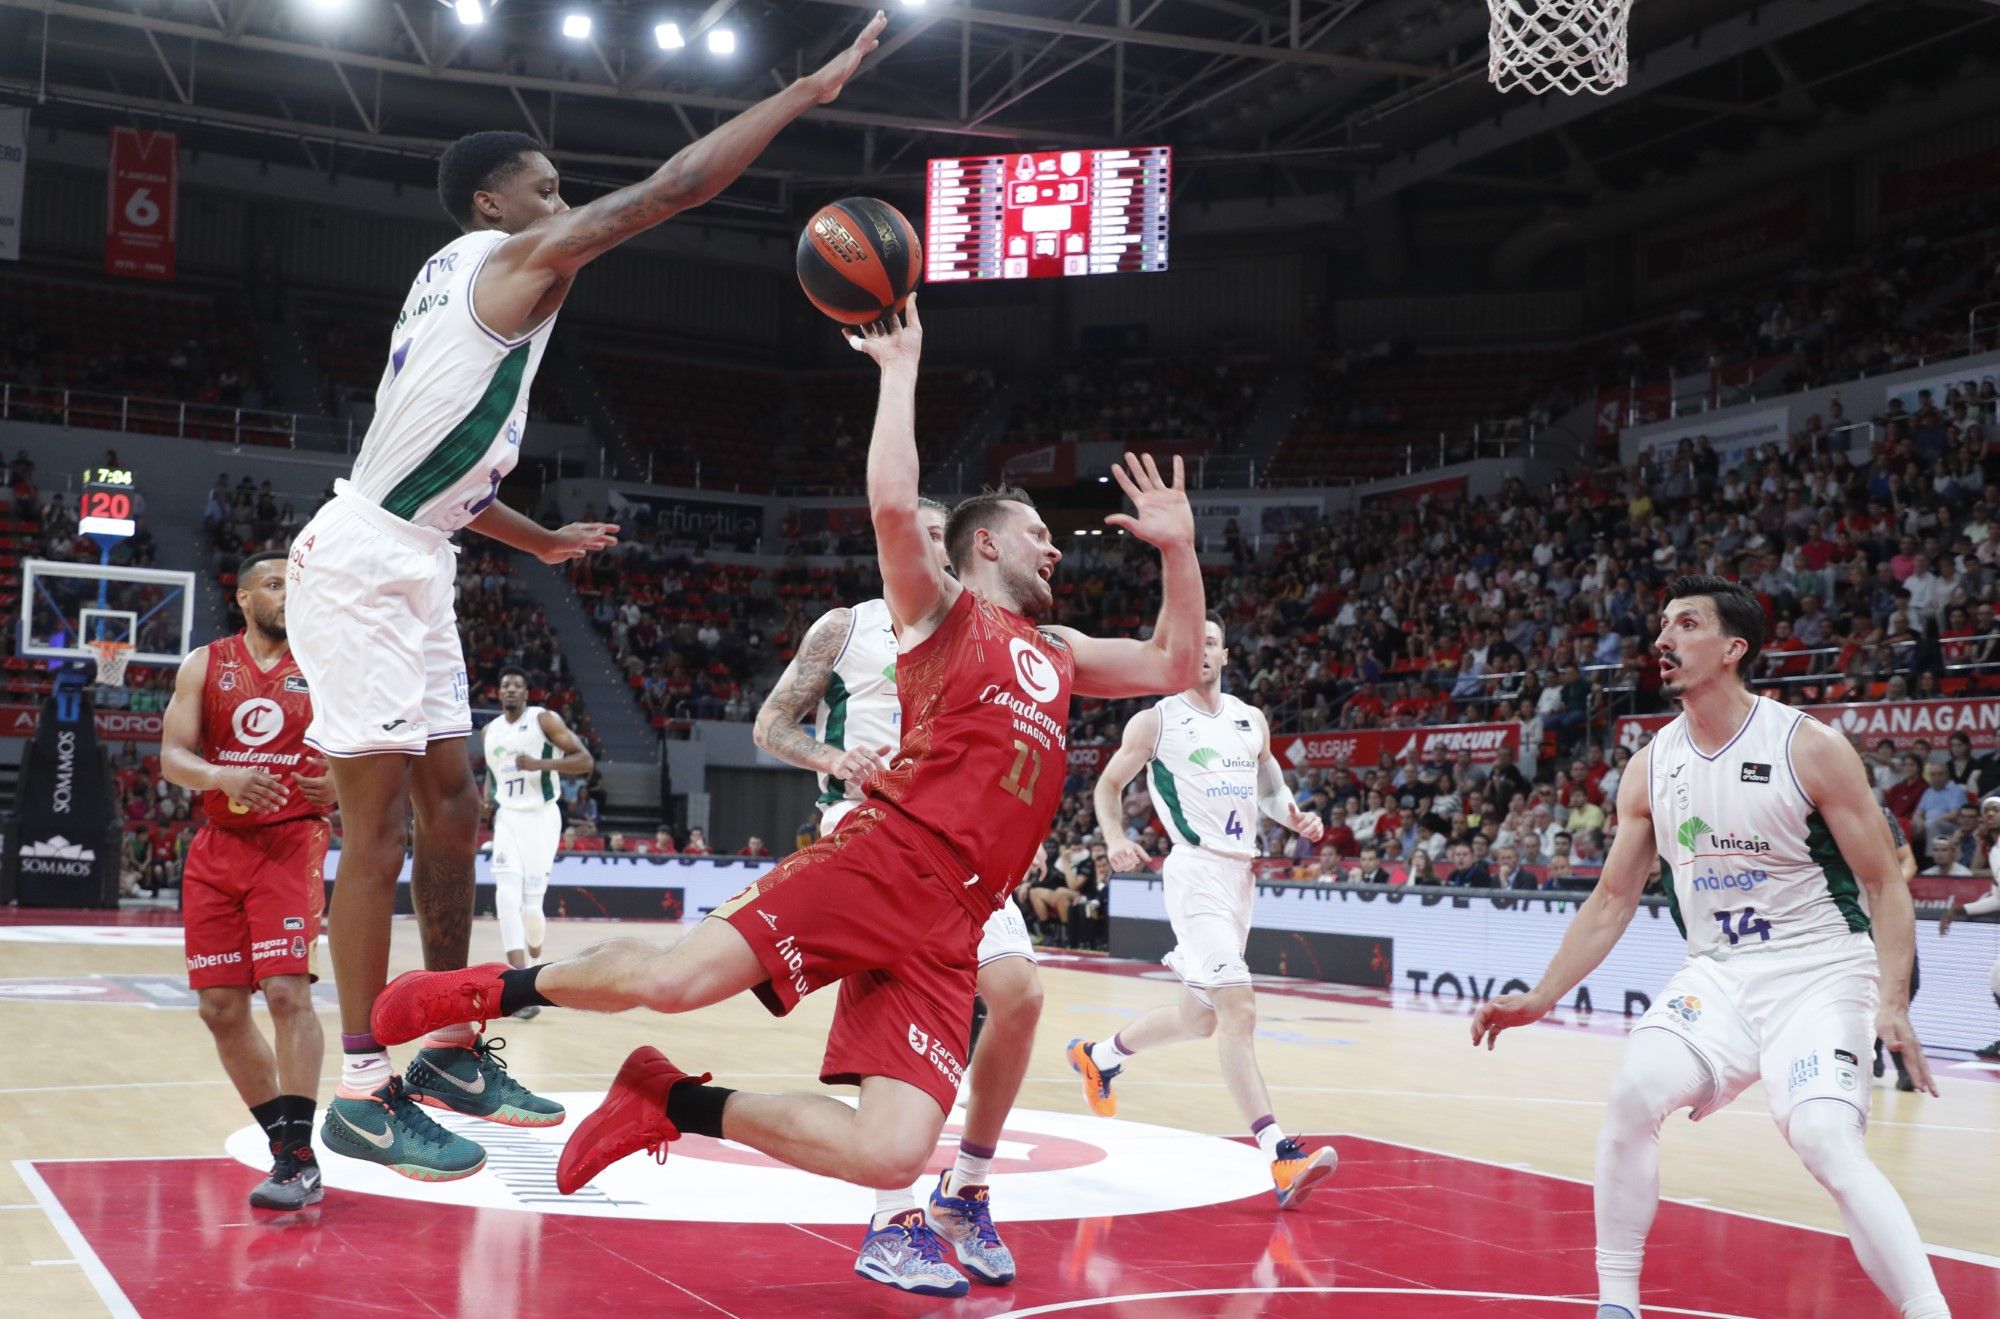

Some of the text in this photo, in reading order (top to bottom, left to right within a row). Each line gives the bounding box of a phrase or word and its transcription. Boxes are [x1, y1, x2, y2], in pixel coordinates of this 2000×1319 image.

[125, 188, 160, 226] 6
[97, 468, 132, 485] 7:04
[91, 492, 131, 519] 20
[1012, 714, 1051, 750] ARAGOZA
[1421, 730, 1508, 751] MERCURY
[219, 748, 301, 766] asademont
[1307, 738, 1358, 759] SUGRAF
[53, 730, 76, 814] SOMMOS
[998, 739, 1041, 807] 11
[505, 777, 526, 797] 77
[1225, 809, 1244, 841] 4
[1711, 832, 1771, 853] Unicaja
[20, 858, 92, 878] SOMMOS
[1714, 906, 1773, 945] 14
[187, 951, 242, 970] hiberus
